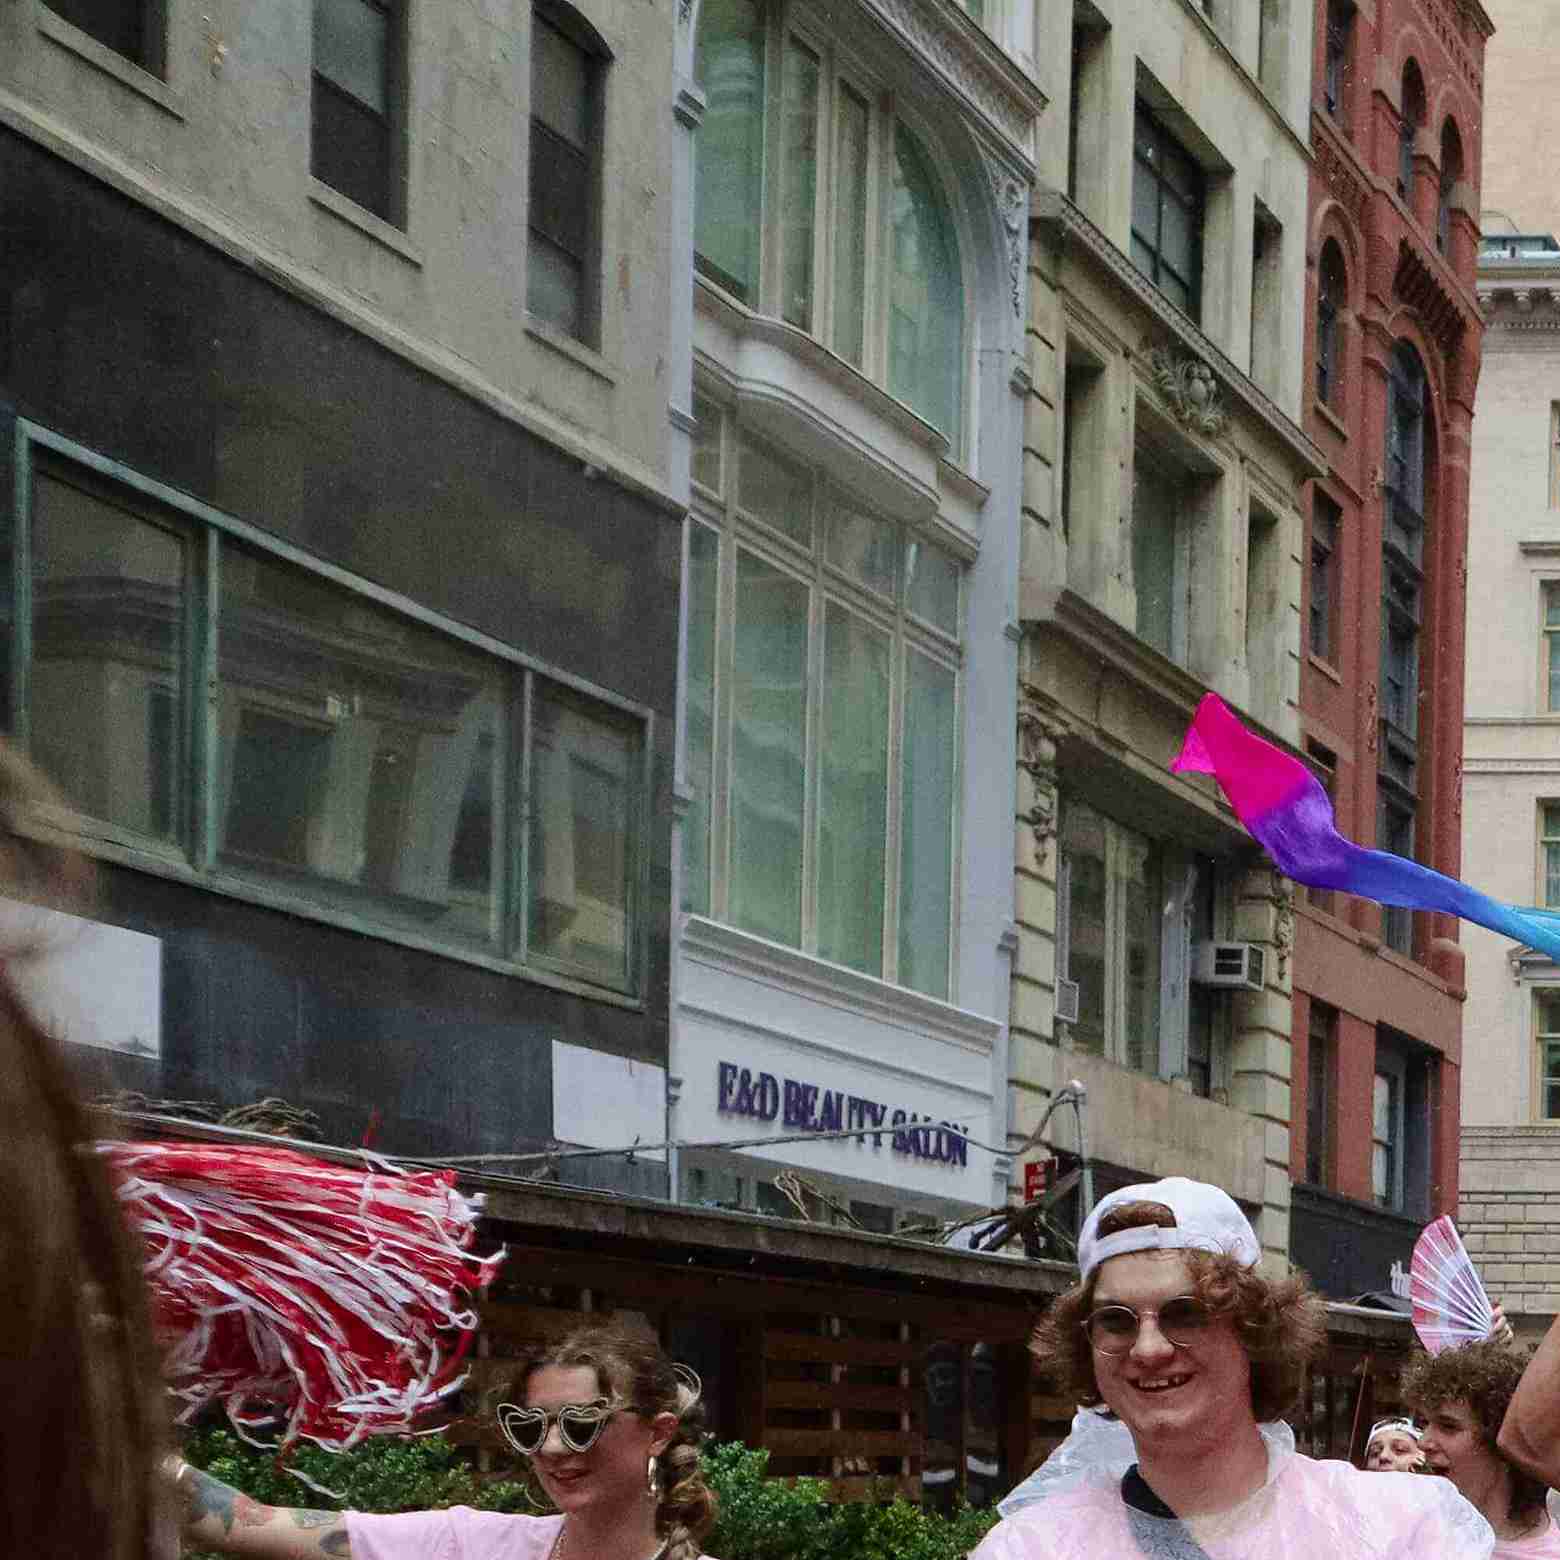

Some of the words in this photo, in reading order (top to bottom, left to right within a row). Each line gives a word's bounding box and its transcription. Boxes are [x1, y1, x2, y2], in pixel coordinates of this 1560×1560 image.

[717, 1060, 780, 1122] E&D
[782, 1078, 887, 1147] BEAUTY
[891, 1109, 968, 1167] SALON
